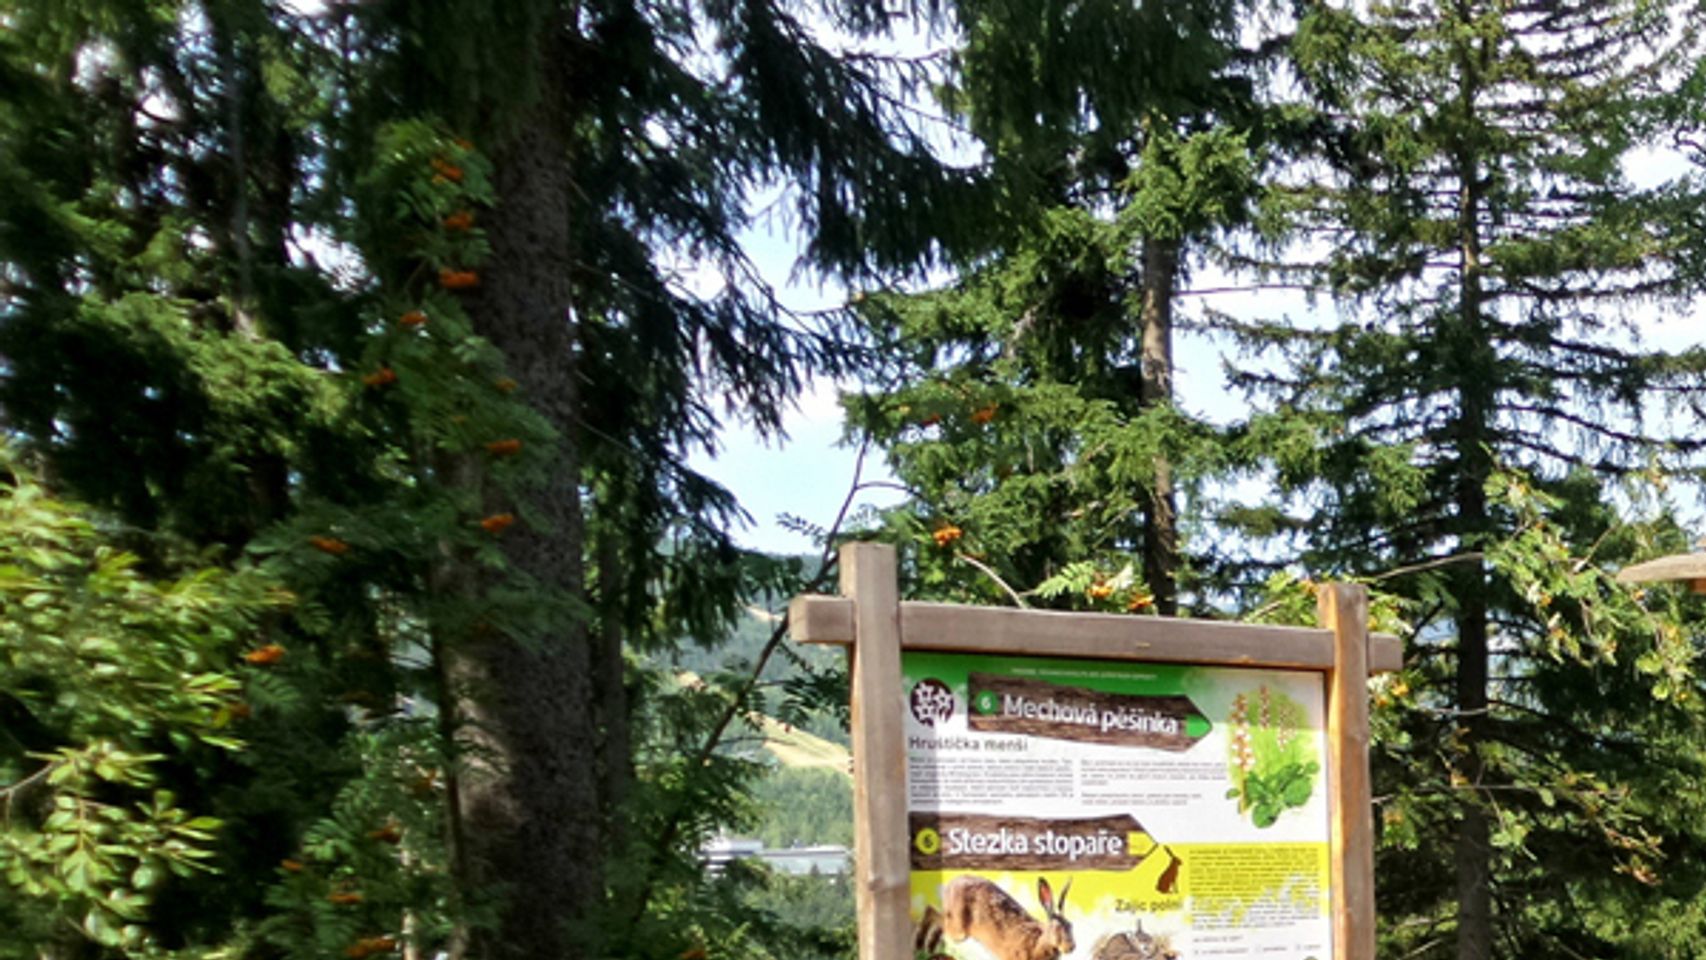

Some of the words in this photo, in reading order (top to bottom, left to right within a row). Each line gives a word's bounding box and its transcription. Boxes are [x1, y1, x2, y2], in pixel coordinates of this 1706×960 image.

[981, 696, 992, 710] 6
[1003, 693, 1098, 725] Mechová
[947, 827, 1031, 856] Stezka
[1036, 829, 1123, 861] stopaře
